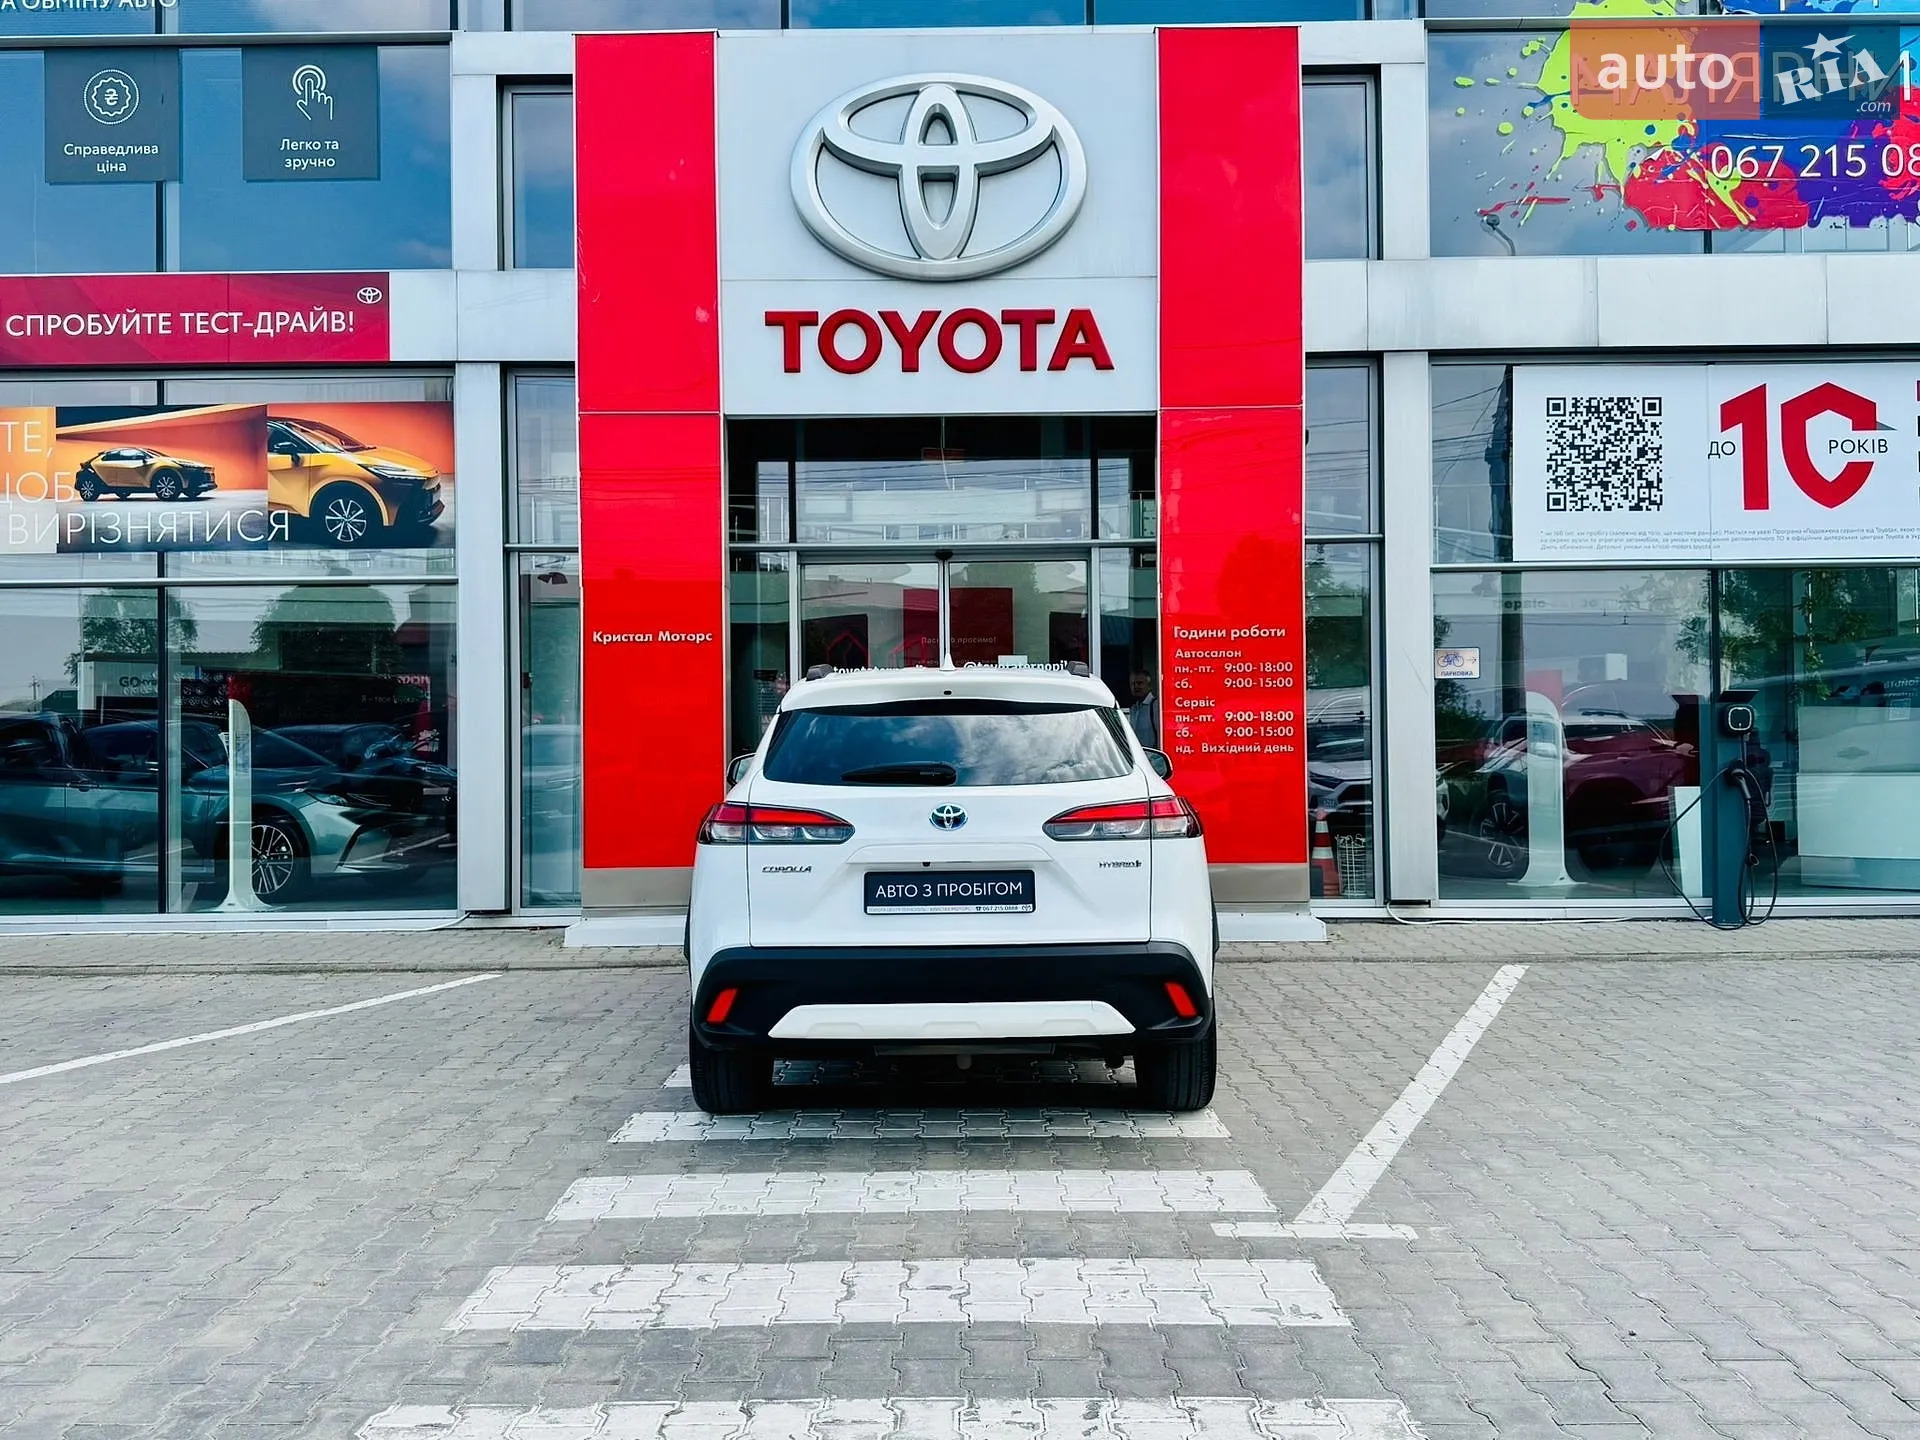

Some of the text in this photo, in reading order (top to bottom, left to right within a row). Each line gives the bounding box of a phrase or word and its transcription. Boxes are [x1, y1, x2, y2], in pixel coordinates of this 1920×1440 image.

[64, 143, 158, 157] Справедлива
[280, 139, 340, 151] Легко та
[97, 159, 127, 173] ціна
[284, 157, 335, 170] зручно
[1711, 144, 1920, 179] 067 215 08
[5, 305, 355, 337] СПРОБУЙТЕ ТЕСТ-ДРАЙВ!
[765, 308, 1115, 374] TOYOTA
[1708, 441, 1735, 460] ДО
[1829, 439, 1888, 454] РОКІВ
[9, 510, 289, 545] ВИРІЗНЯТИСЯ
[592, 630, 713, 645] Кристал Моторс
[1173, 624, 1286, 640] Години роботи
[1175, 648, 1242, 659] Автосалон
[1174, 662, 1293, 673] пн.-пт. 9:00-18:00
[1174, 677, 1293, 689] сб. 9:00-15:00
[1175, 696, 1216, 710] Сервіс
[1175, 711, 1294, 722] пн.-пт. 9:00-18:00
[1175, 726, 1294, 738] сб. 9:00-15:00
[1175, 741, 1295, 755] нд. Вихідний день
[875, 881, 1023, 898] АВТО З ПРОБІГОМ
